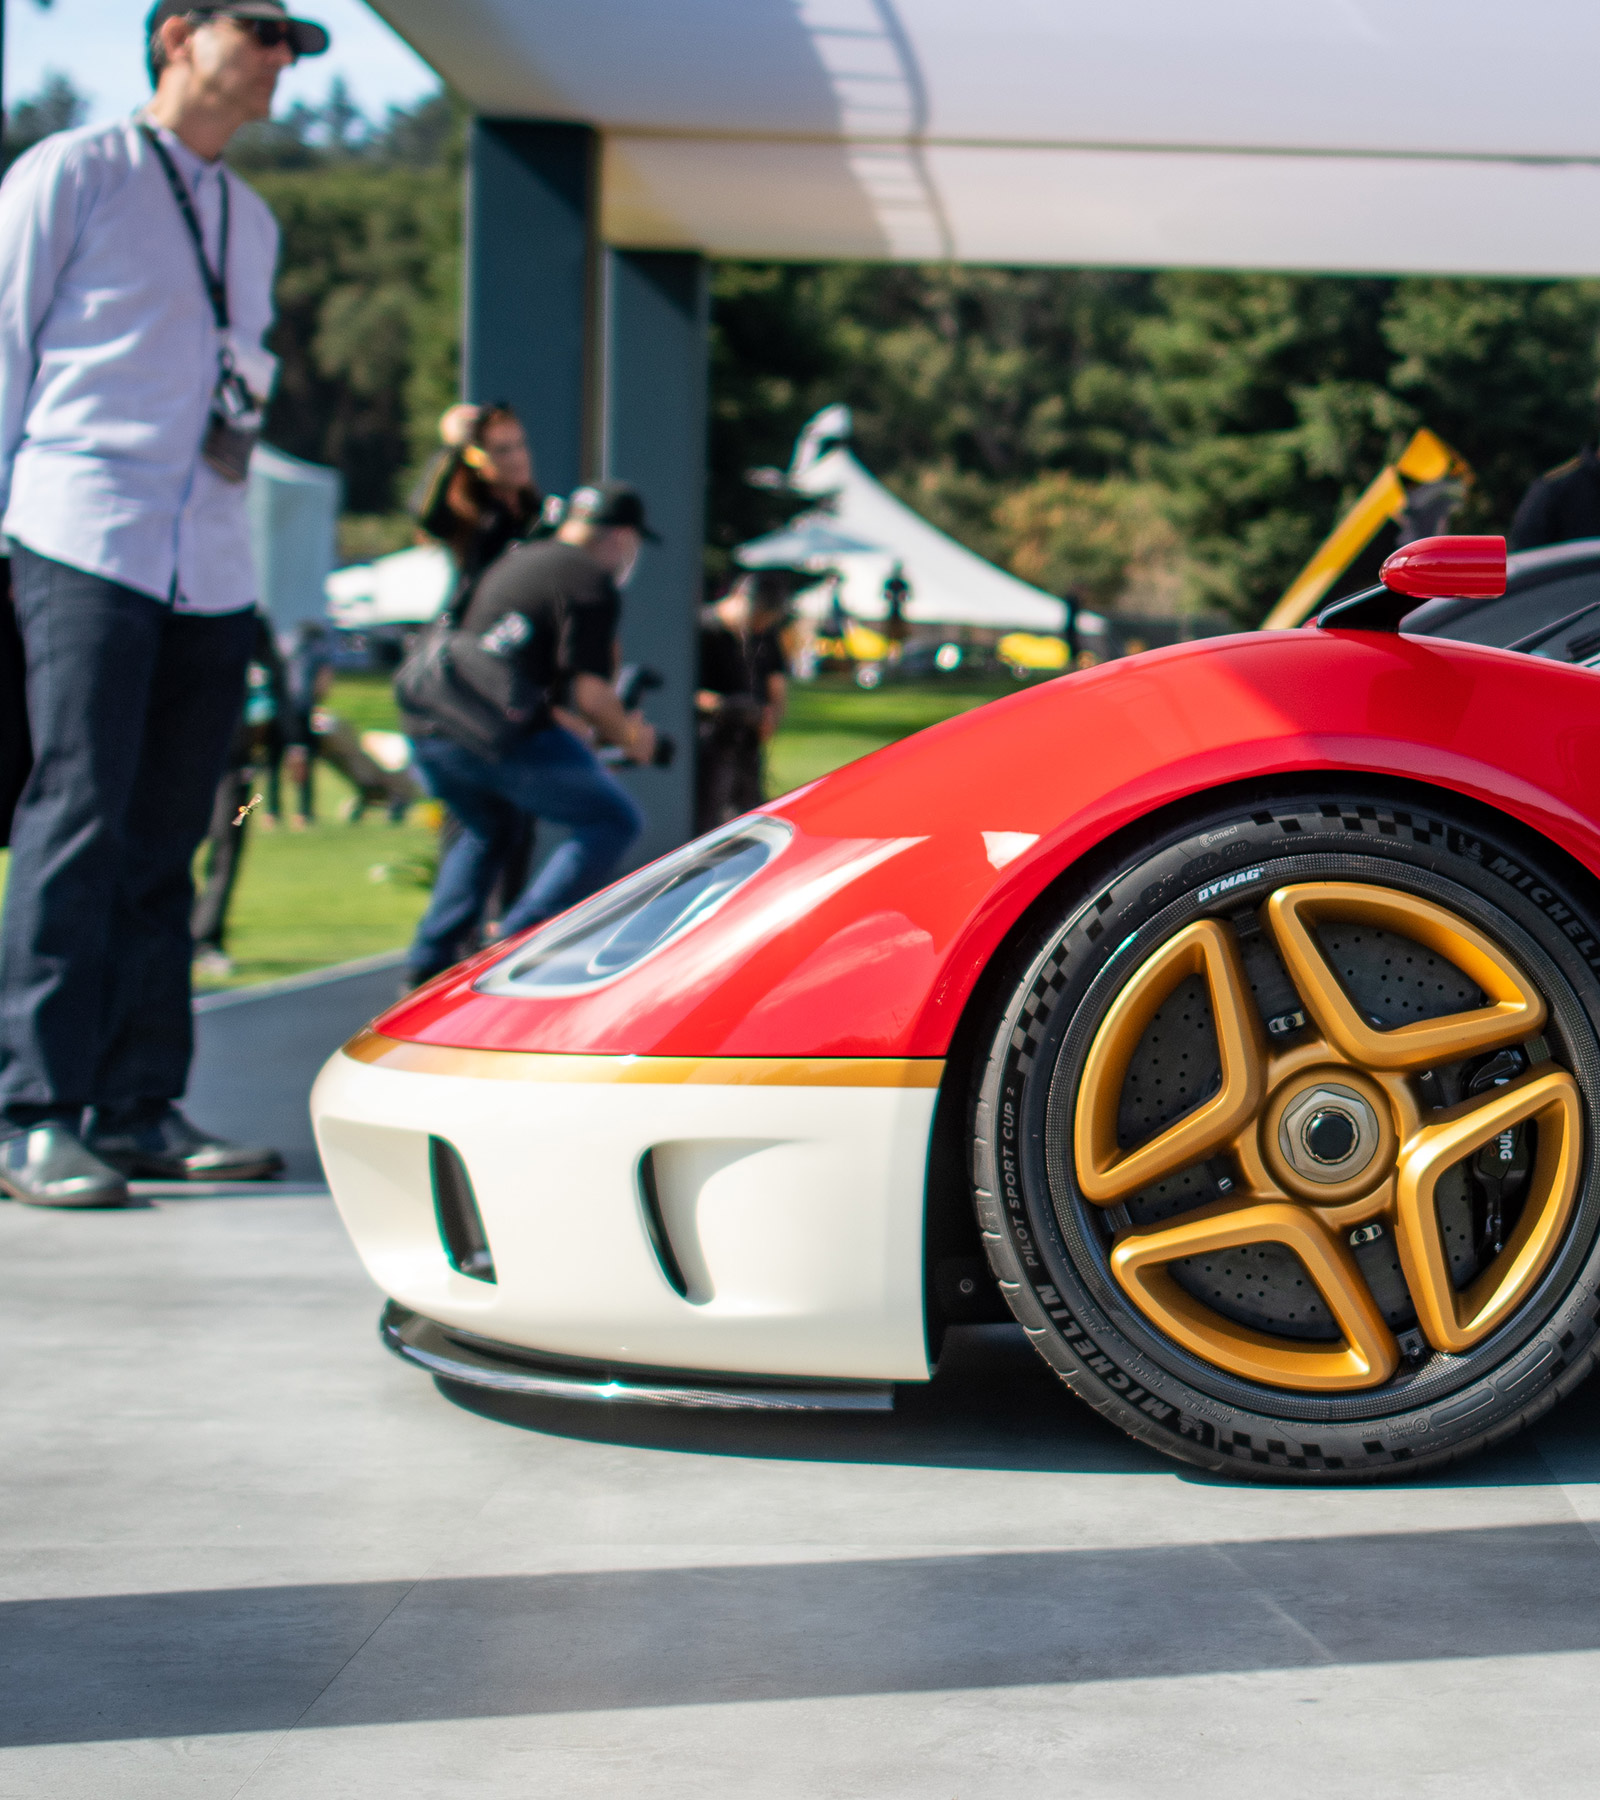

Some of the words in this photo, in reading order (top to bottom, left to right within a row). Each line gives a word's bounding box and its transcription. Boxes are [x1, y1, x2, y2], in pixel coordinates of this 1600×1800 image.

[1005, 1087, 1014, 1096] 2
[1003, 1102, 1016, 1138] CUP
[1500, 1129, 1513, 1160] ING
[1002, 1145, 1020, 1210] SPORT
[1012, 1215, 1039, 1268] PILOT
[1563, 1278, 1596, 1322] OUTSIDE
[1037, 1282, 1172, 1420] MICHELIN
